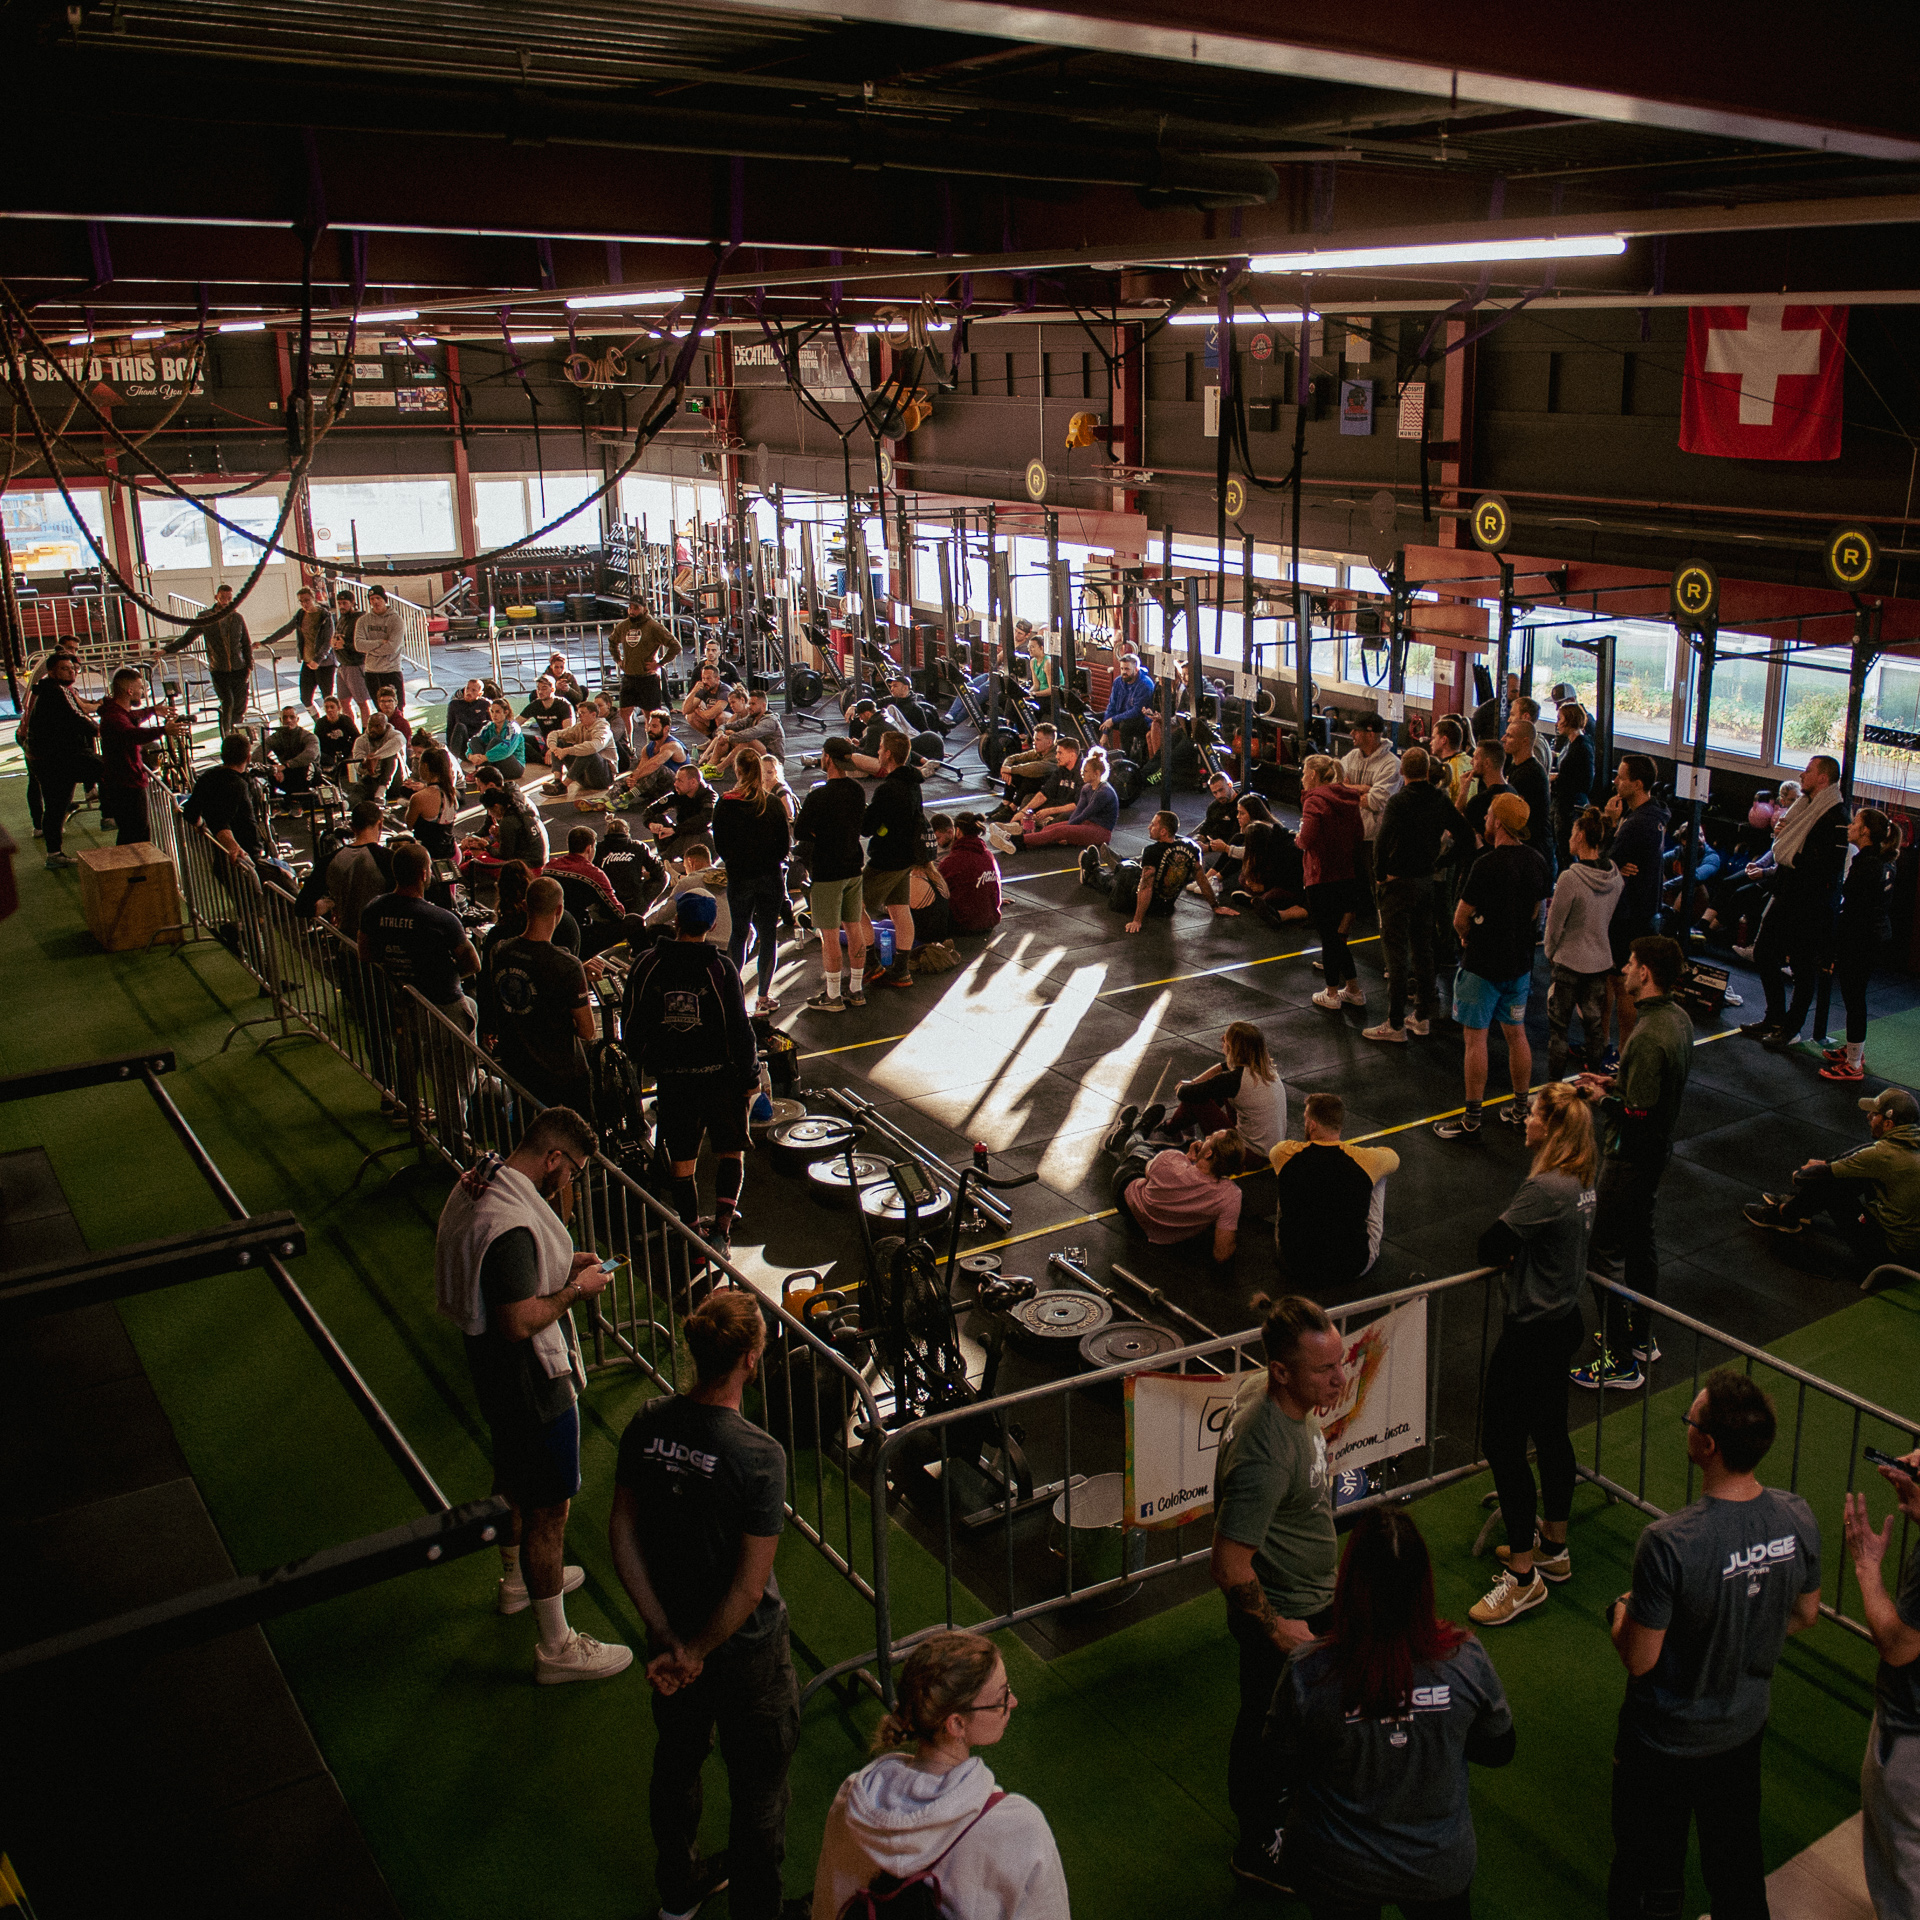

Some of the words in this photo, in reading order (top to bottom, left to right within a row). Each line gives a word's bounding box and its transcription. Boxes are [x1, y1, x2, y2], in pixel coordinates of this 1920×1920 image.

[108, 357, 157, 382] THIS
[126, 385, 158, 397] Thank
[160, 384, 182, 400] You
[1227, 493, 1237, 504] R
[1484, 515, 1497, 531] R
[1843, 548, 1859, 566] R
[1687, 583, 1701, 600] R
[1387, 698, 1393, 709] 2
[601, 852, 635, 868] Athlete
[379, 916, 414, 930] ATHLETE
[1335, 1422, 1410, 1460] coloroom_insta
[643, 1437, 719, 1473] JUDGE
[1158, 1484, 1209, 1512] ColoRoom
[1722, 1535, 1796, 1576] JUDGE
